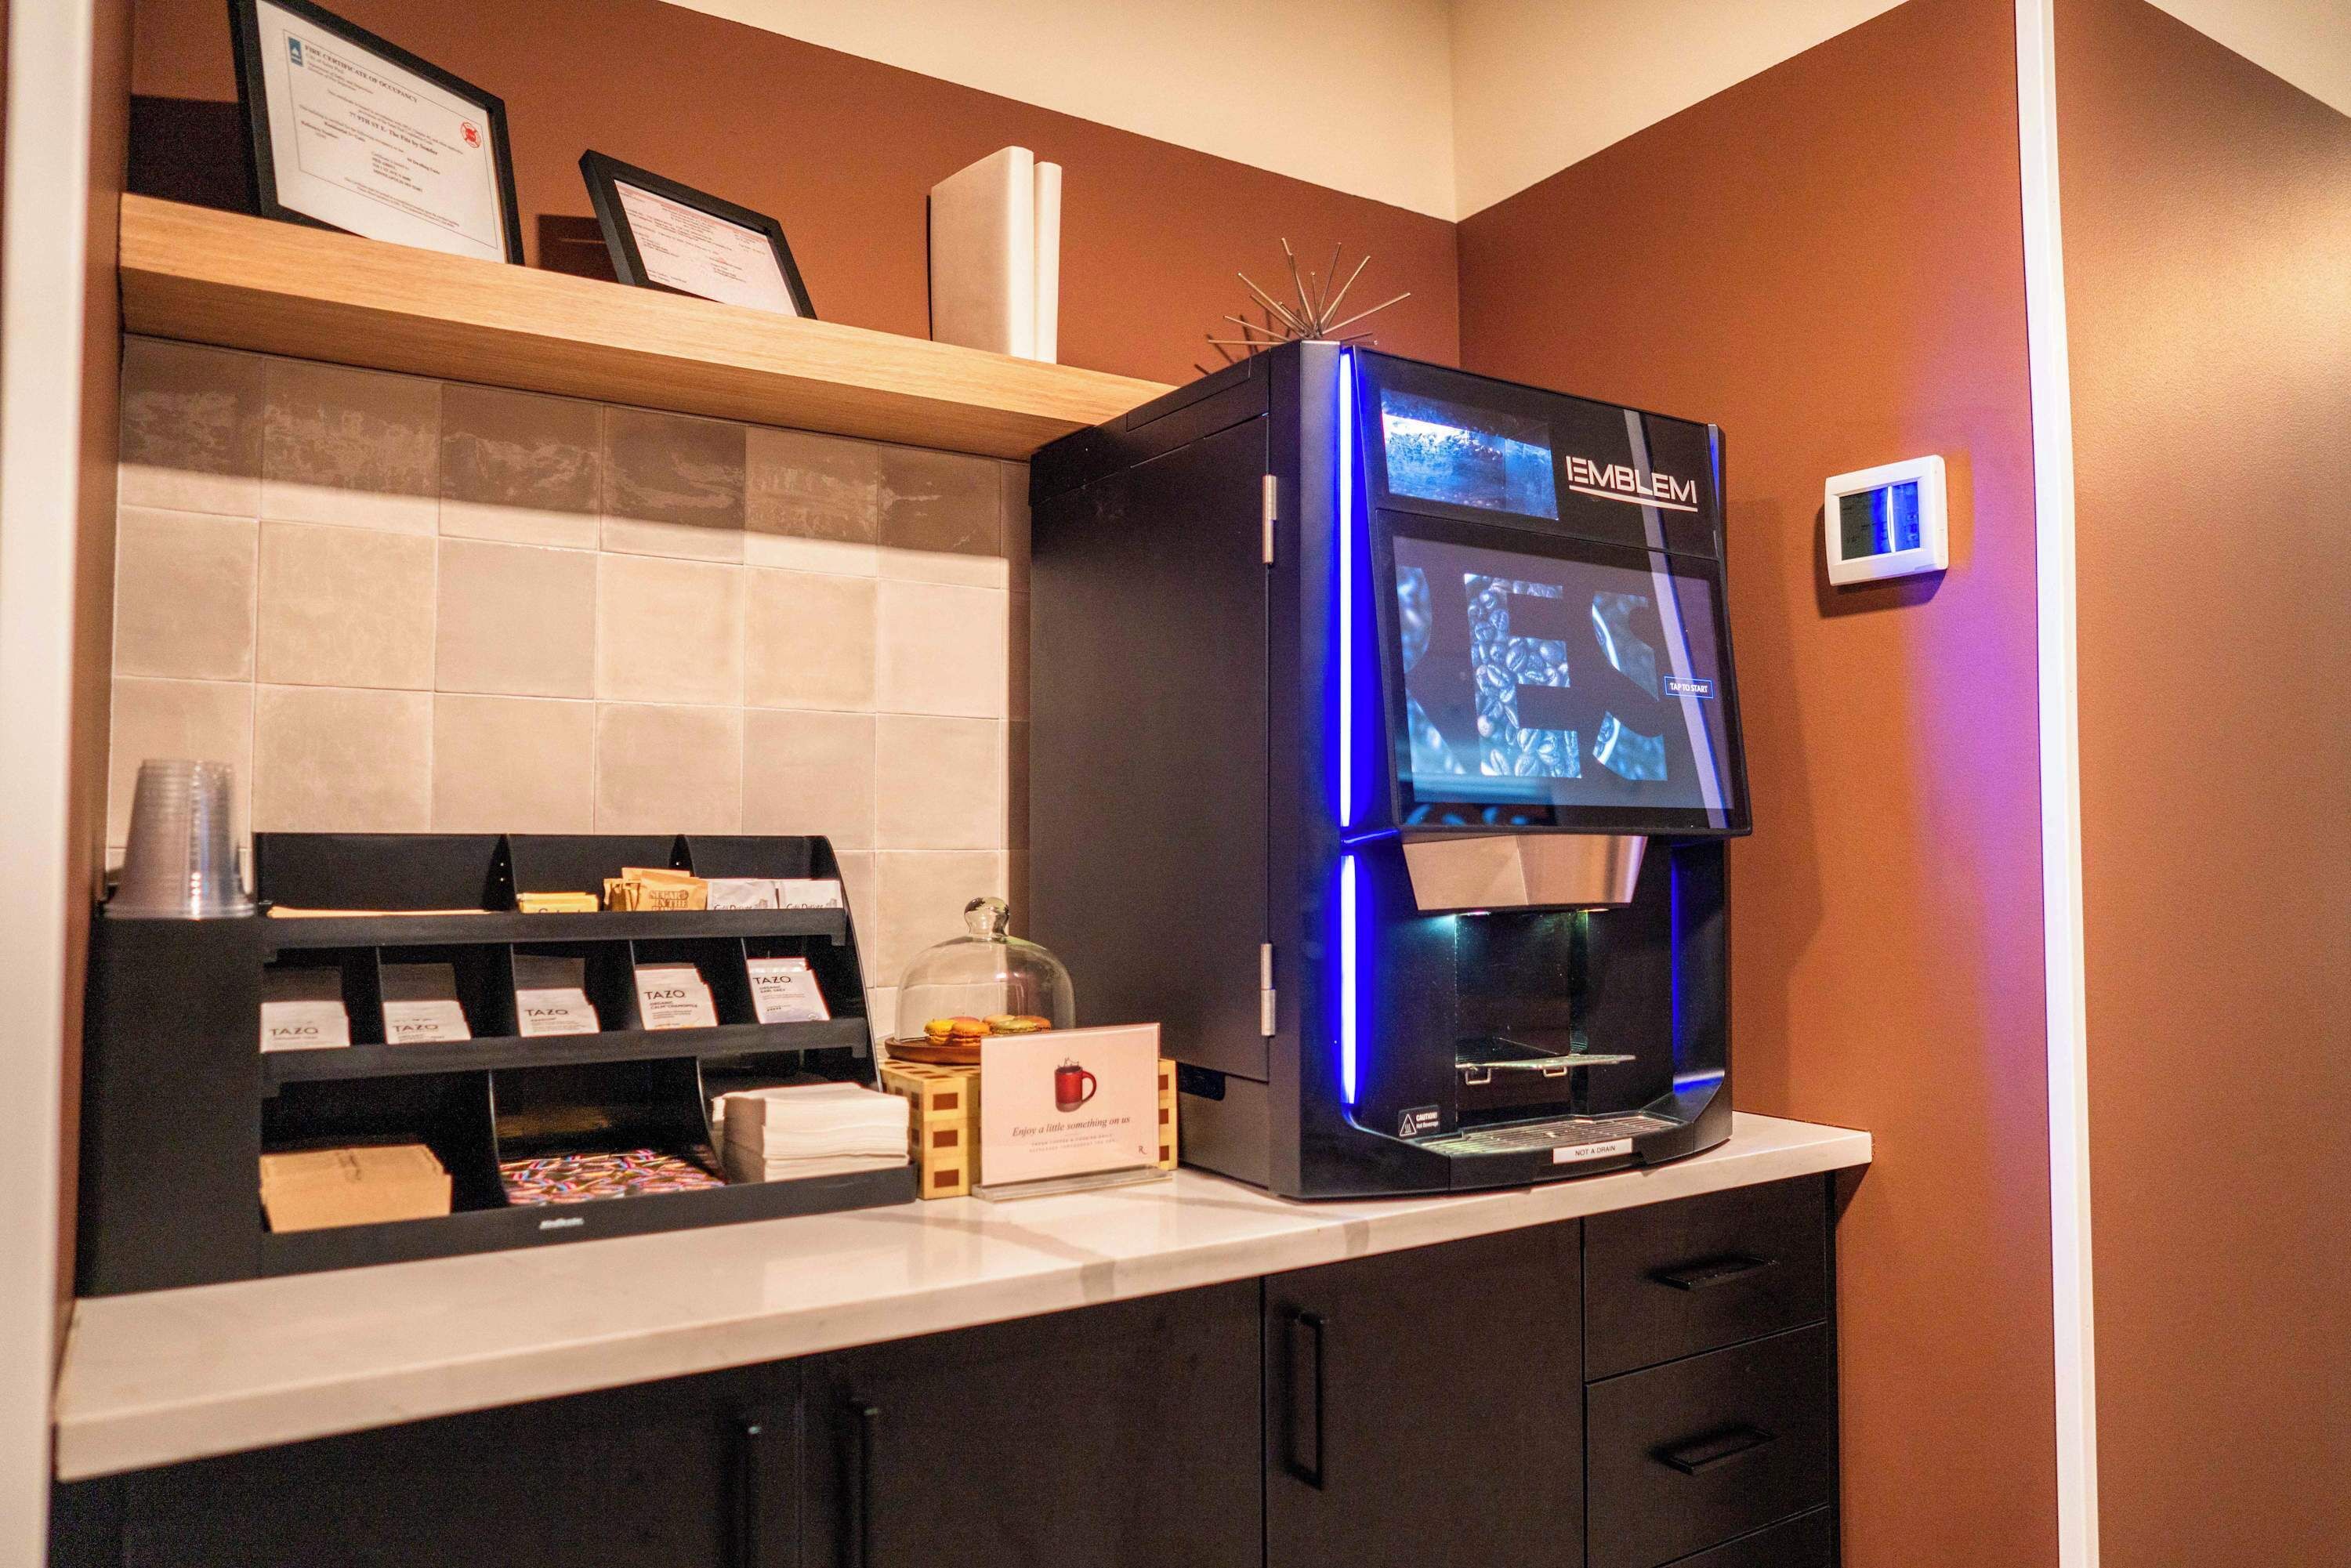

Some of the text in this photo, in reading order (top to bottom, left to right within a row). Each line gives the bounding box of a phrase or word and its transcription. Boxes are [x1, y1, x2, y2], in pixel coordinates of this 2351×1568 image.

[323, 53, 368, 79] CERTIFICATE
[379, 81, 418, 103] OCCUPANCY
[1566, 455, 1697, 504] EMBLEM
[1691, 684, 1708, 693] START
[753, 976, 792, 985] TAZO
[643, 990, 686, 1000] TAZO
[524, 1009, 570, 1017] TAZO
[269, 1027, 318, 1036] TAZO
[1416, 1112, 1437, 1121] CAUTION!
[1012, 1126, 1037, 1139] Enjoy
[1046, 1122, 1065, 1133] little
[1067, 1117, 1108, 1130] something
[1121, 1116, 1131, 1124] us
